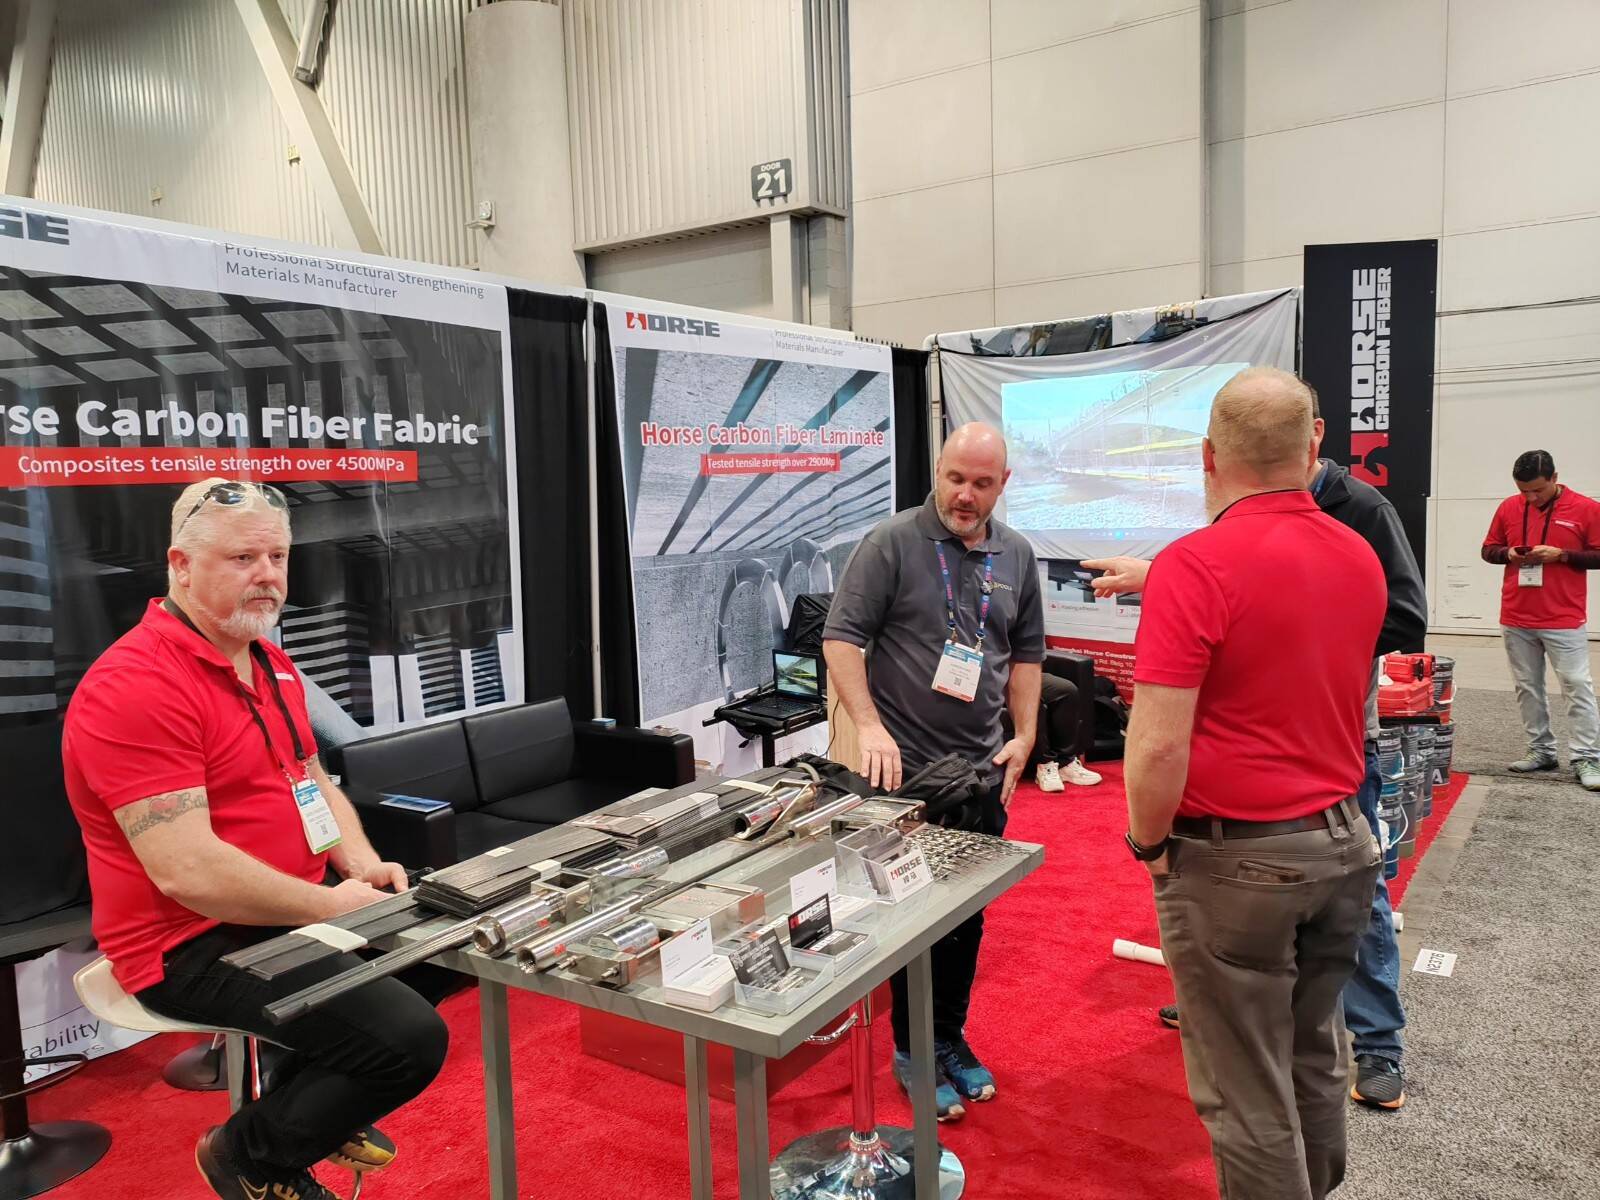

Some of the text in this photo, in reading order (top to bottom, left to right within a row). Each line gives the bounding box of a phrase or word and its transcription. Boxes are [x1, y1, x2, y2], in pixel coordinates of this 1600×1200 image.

[757, 169, 786, 197] 21
[226, 261, 398, 298] Materials Manufacturer
[325, 258, 394, 281] Structural
[398, 271, 485, 299] Strengthening
[625, 311, 720, 338] HORSE
[1351, 269, 1377, 431] HORSE
[1375, 266, 1392, 431] CARBON FIBER
[0, 400, 479, 445] se Carbon Fiber Fabric
[640, 421, 884, 447] Horse Carbon Fiber Laminate
[18, 455, 405, 477] Composites tensile strength over 4500MPa
[707, 458, 734, 469] Tested
[735, 457, 761, 468] tensile
[761, 457, 791, 470] strength
[791, 460, 808, 468] over
[1432, 768, 1443, 784] A
